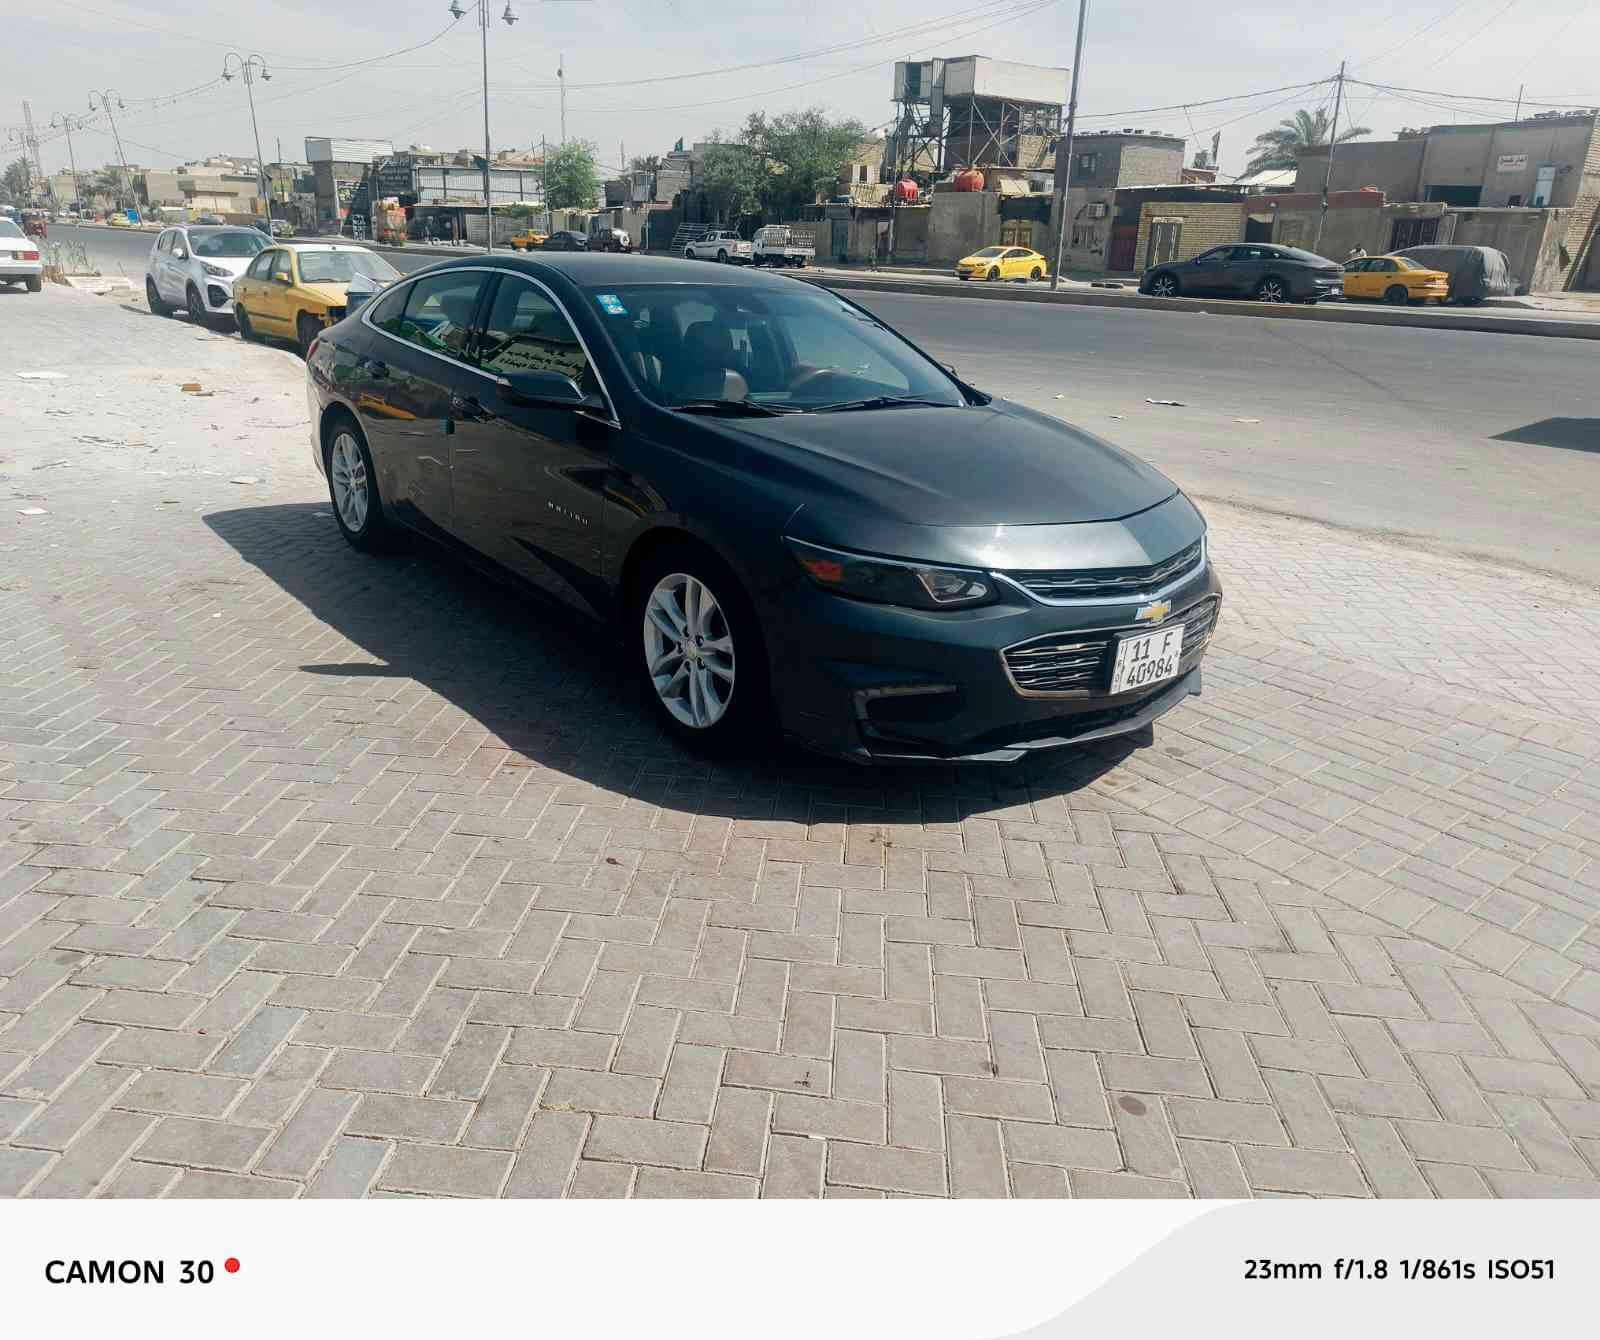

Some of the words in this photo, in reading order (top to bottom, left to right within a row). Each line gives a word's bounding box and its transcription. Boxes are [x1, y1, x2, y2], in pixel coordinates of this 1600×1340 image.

[1130, 638, 1150, 661] 11
[1162, 632, 1174, 654] F
[1127, 656, 1173, 686] 40984
